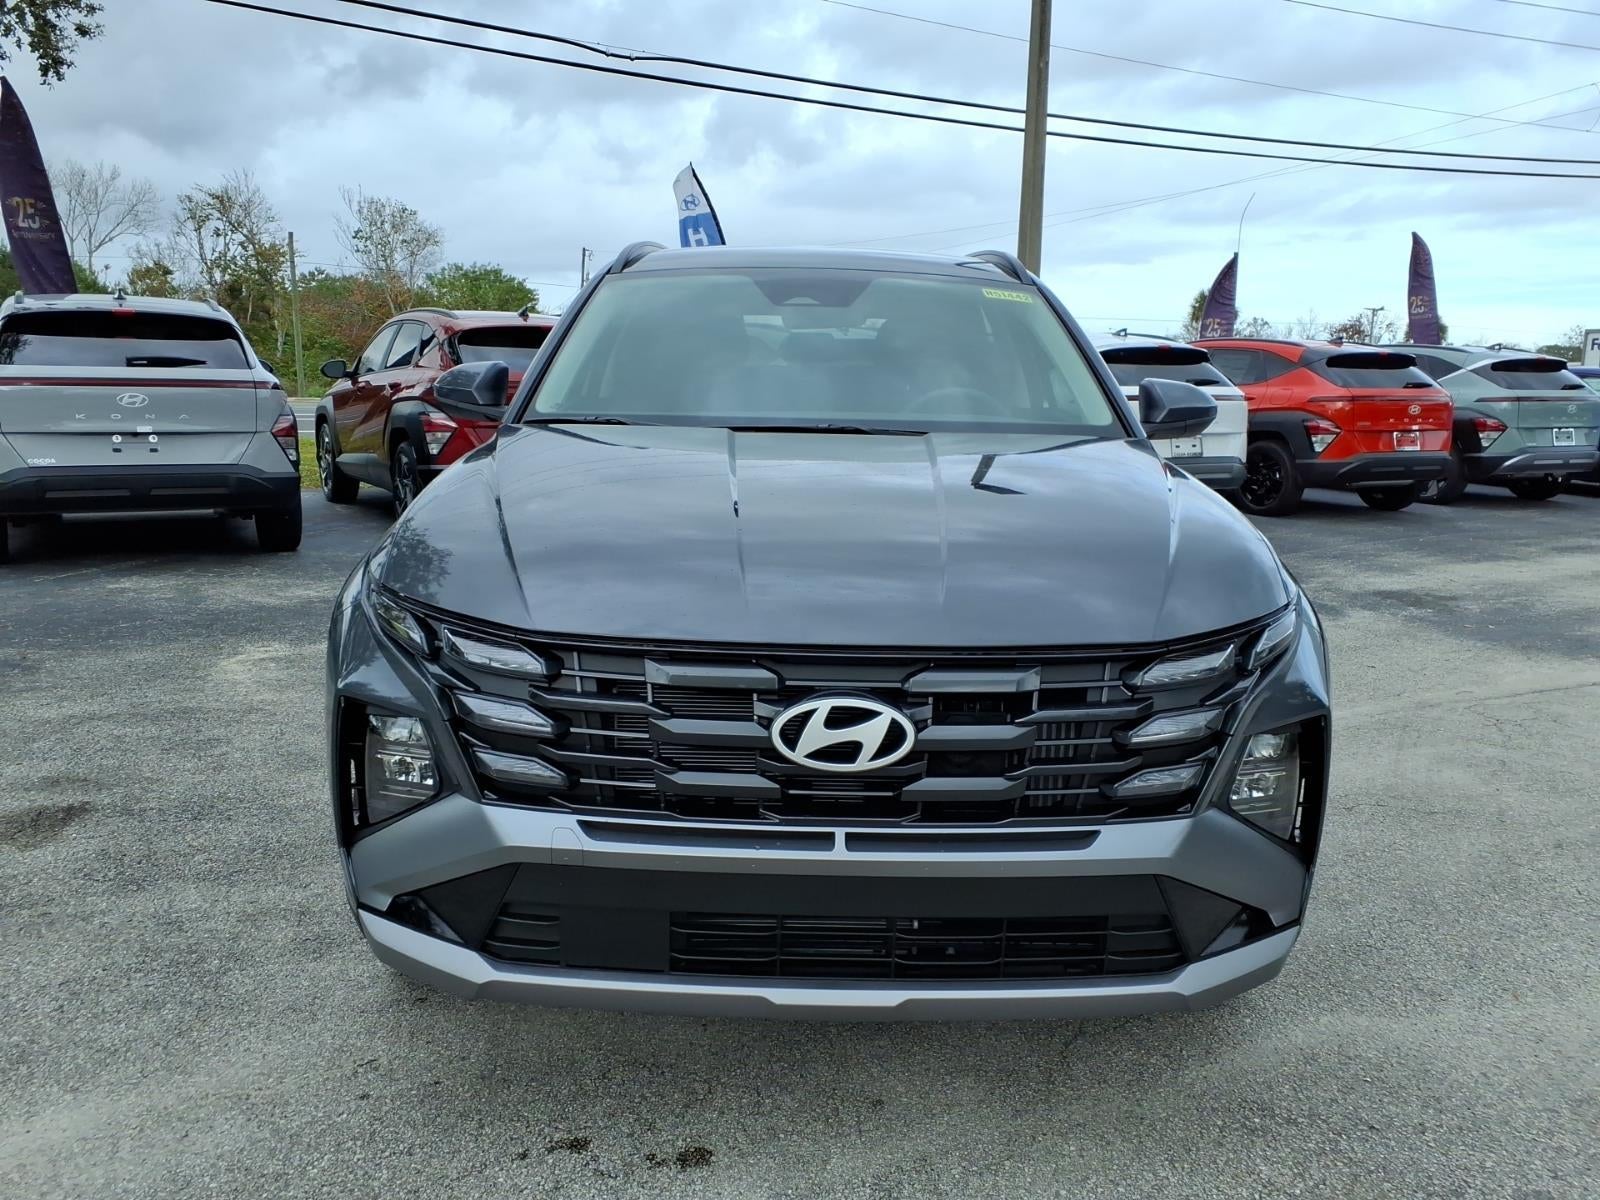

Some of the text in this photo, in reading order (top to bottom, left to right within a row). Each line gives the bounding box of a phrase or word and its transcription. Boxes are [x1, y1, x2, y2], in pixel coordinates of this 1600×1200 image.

[12, 196, 41, 229] 25
[1410, 296, 1424, 314] 25
[1206, 318, 1221, 337] 25
[27, 457, 57, 465] COCOA
